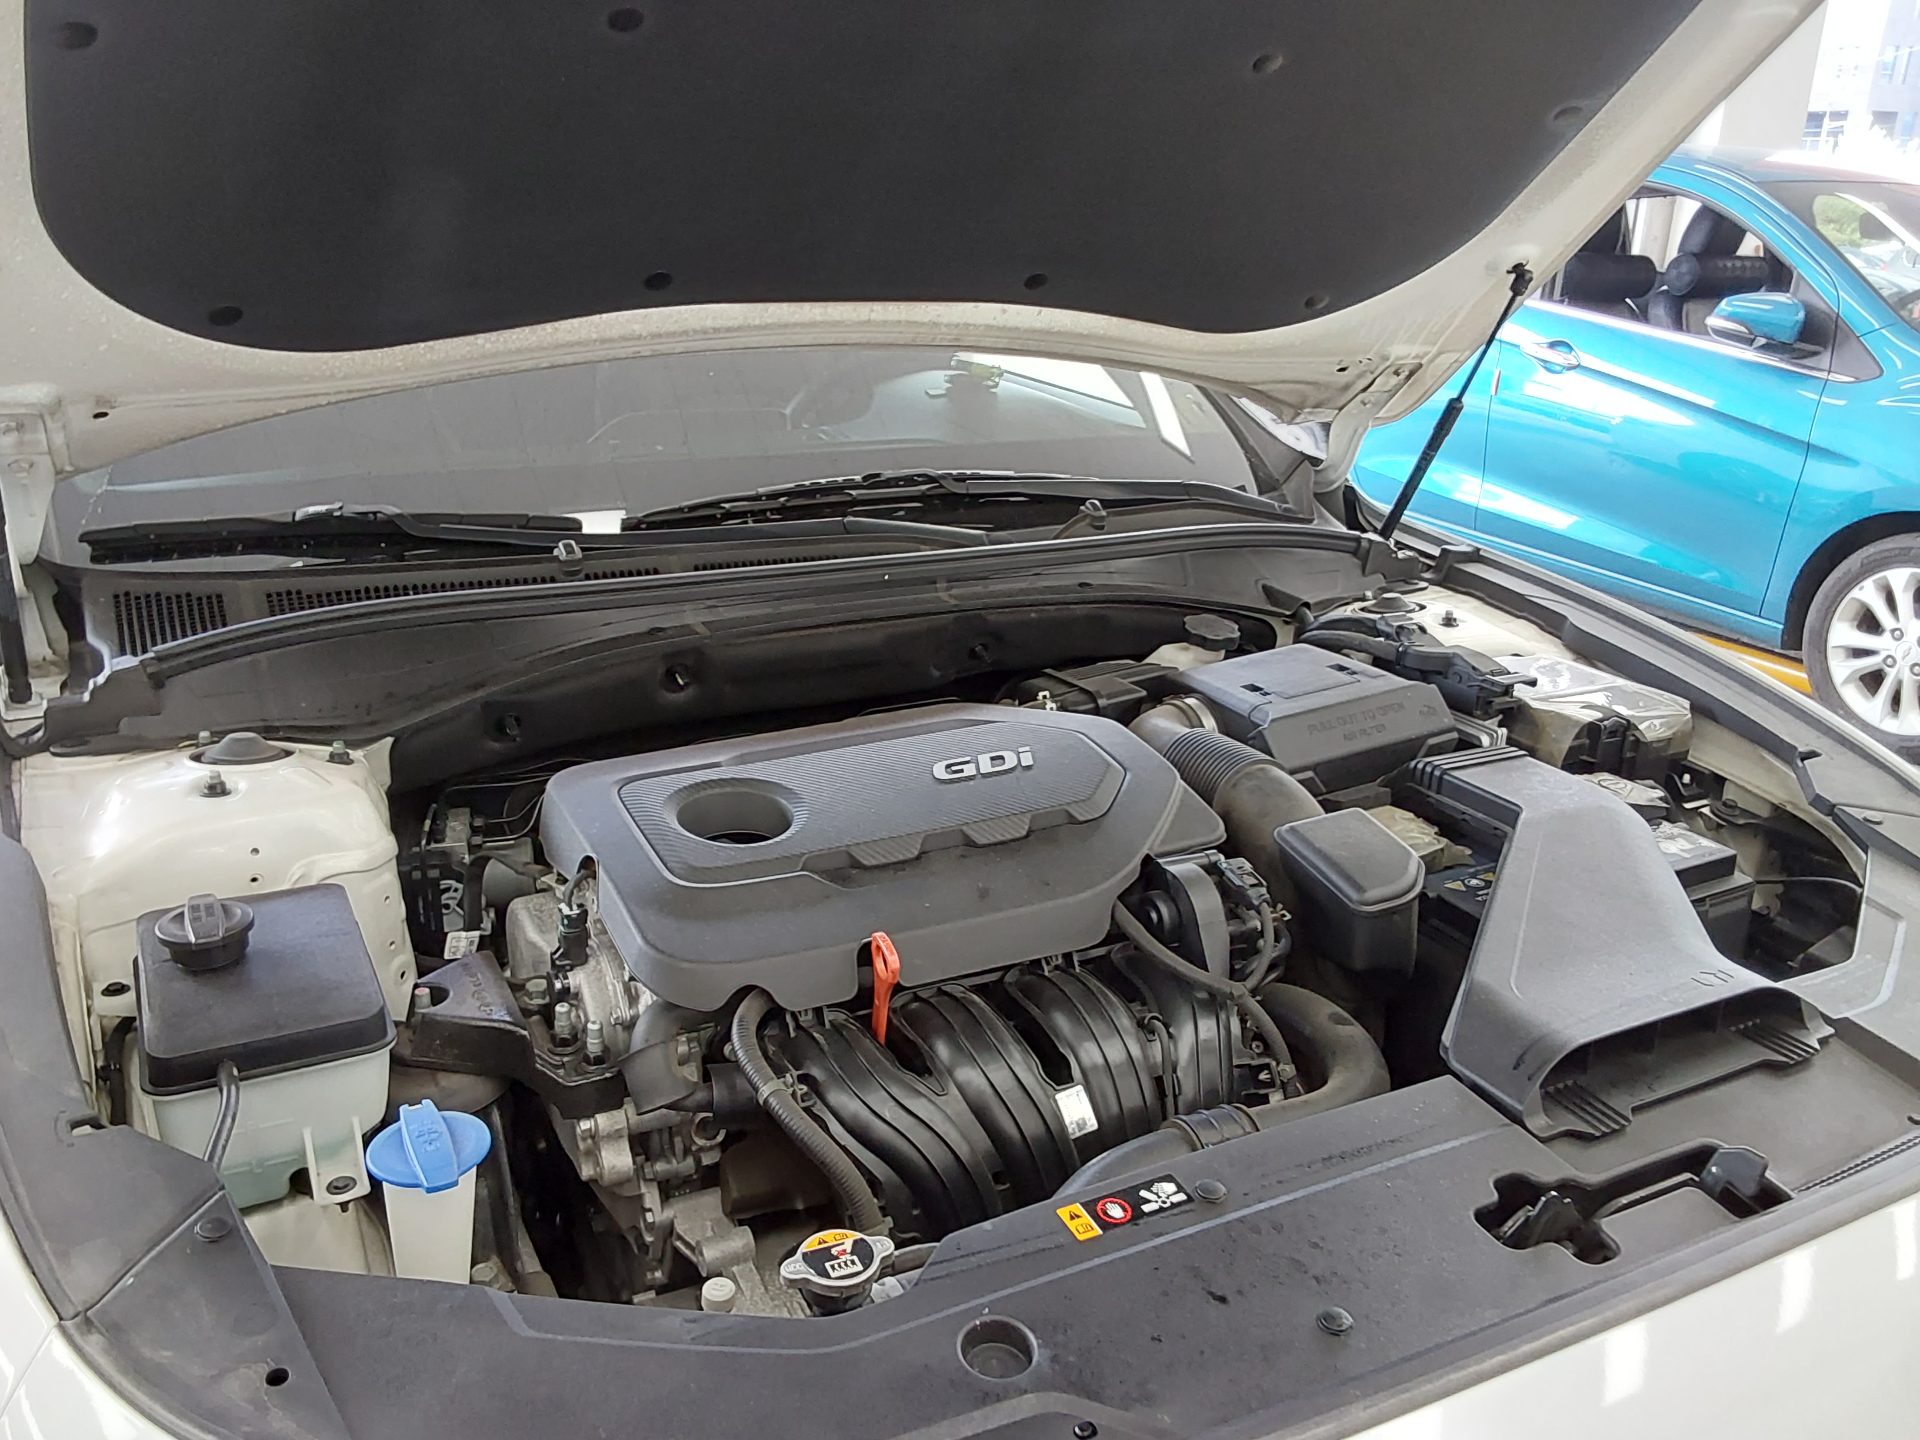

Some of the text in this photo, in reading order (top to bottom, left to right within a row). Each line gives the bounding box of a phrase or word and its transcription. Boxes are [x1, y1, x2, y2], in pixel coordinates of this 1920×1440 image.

[1307, 701, 1406, 735] PULL OUT TO OPEN
[932, 746, 1034, 780] GDi
